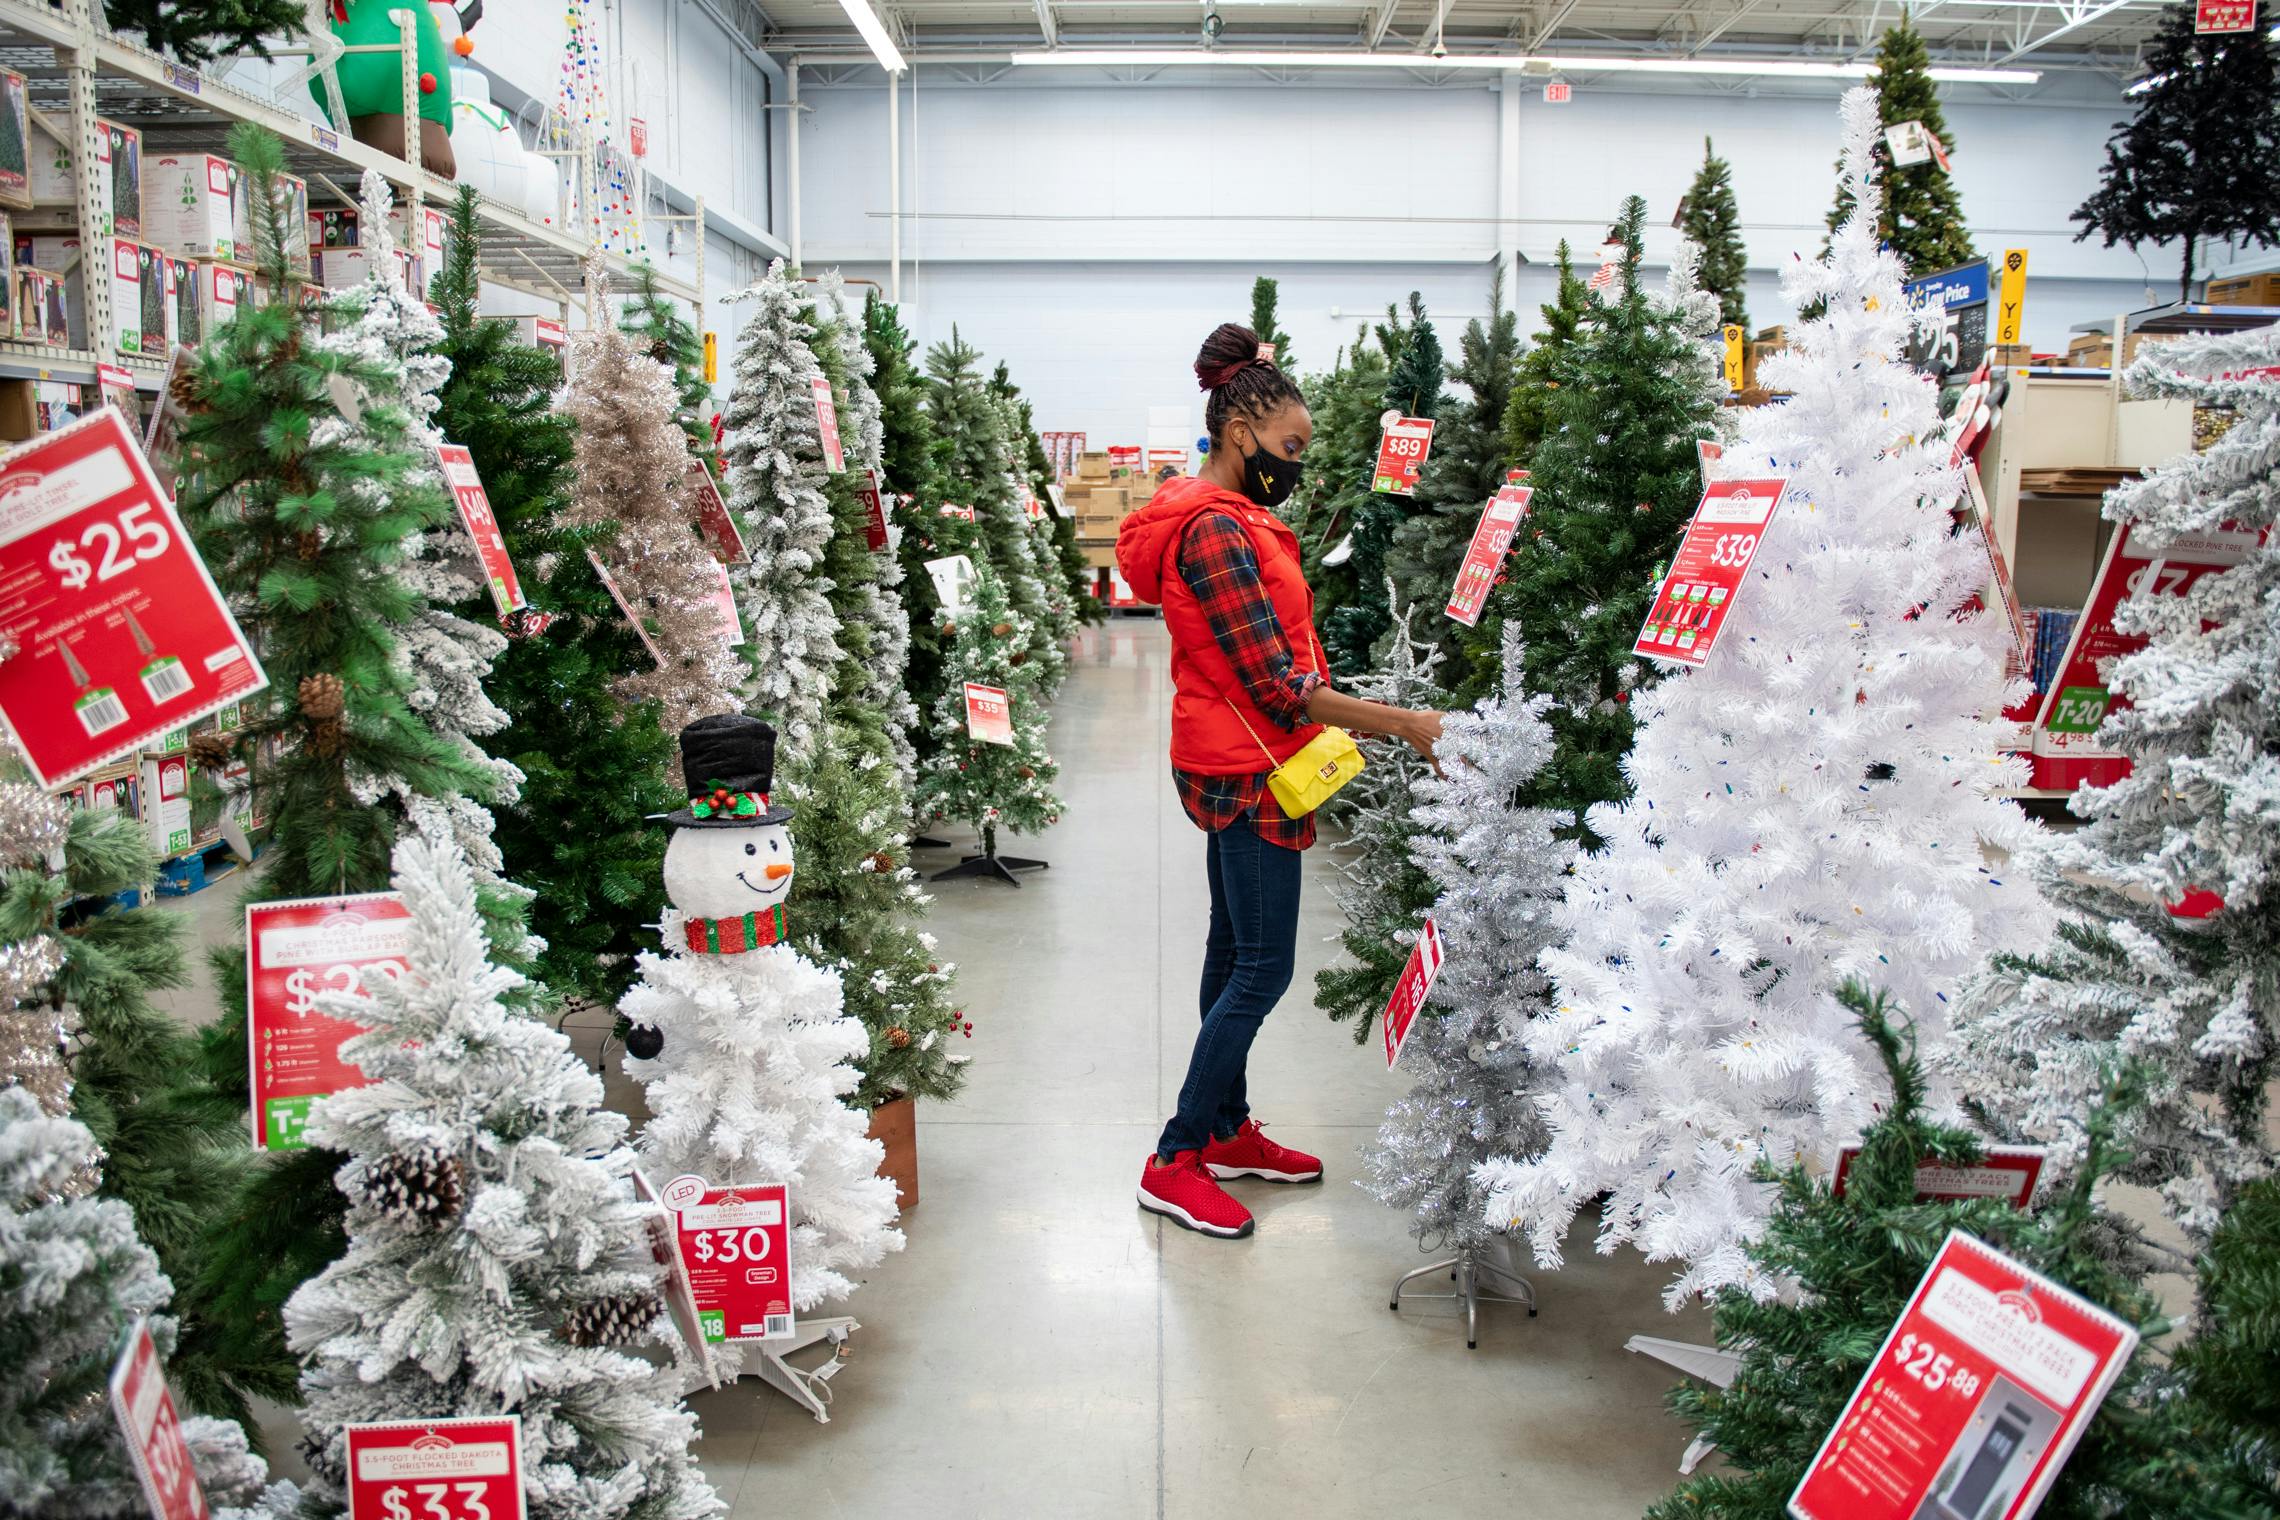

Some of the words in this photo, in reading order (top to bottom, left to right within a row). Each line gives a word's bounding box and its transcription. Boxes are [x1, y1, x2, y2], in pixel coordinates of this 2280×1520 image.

[1549, 86, 1568, 100] EXIT
[1926, 289, 1945, 306] Low
[1945, 283, 1970, 304] Price
[2005, 302, 2017, 318] Y
[2003, 325, 2013, 340] 6
[1729, 361, 1738, 373] Y
[1388, 438, 1421, 457] $89
[462, 489, 492, 526] $49
[48, 501, 171, 590] $25
[1488, 528, 1511, 554] $39
[1711, 533, 1757, 567] $39
[2172, 539, 2204, 549] LOCKED
[2205, 541, 2224, 551] PINE
[2224, 543, 2244, 553] TREE
[34, 618, 77, 645] Available
[2057, 699, 2104, 725] T-20
[271, 1108, 304, 1134] T-
[671, 1185, 695, 1201] LED
[719, 1211, 754, 1219] SNOWMAN
[694, 1227, 771, 1264] $30
[702, 1318, 723, 1337] 18
[1941, 1291, 1976, 1319] PORCH
[1975, 1314, 2033, 1356] CHRISTMAS
[2038, 1351, 2071, 1379] TREES
[1894, 1333, 1980, 1398] $25.88
[2046, 1342, 2076, 1366] PACK
[392, 1461, 447, 1471] CHRISTMAS
[451, 1460, 475, 1468] TREE
[412, 1451, 458, 1461] FLOCKED
[461, 1449, 502, 1459] DAKOTA
[382, 1482, 490, 1520] $33
